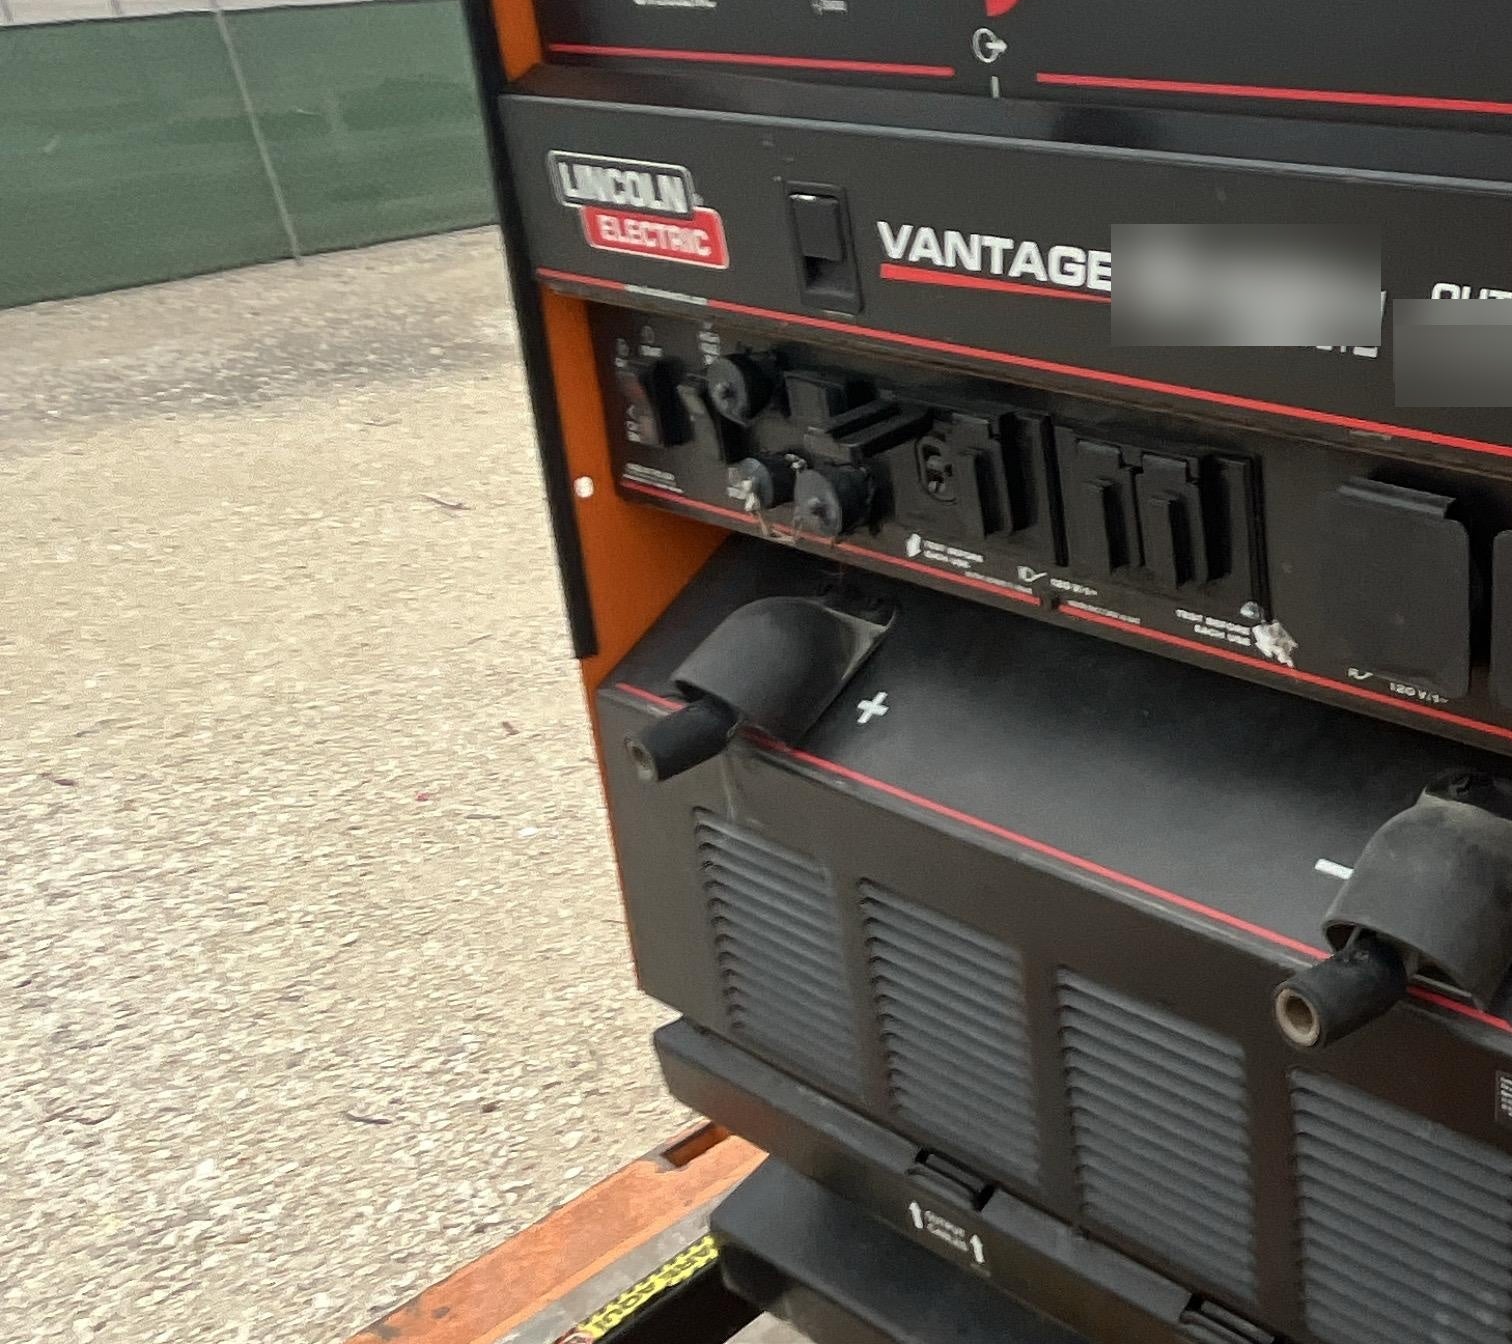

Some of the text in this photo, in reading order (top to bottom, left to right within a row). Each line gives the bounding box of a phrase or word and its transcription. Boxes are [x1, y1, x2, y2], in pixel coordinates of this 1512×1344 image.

[558, 161, 690, 215] LINCOLN
[595, 214, 713, 257] ELECTRIC
[876, 220, 1112, 292] VANTAGE
